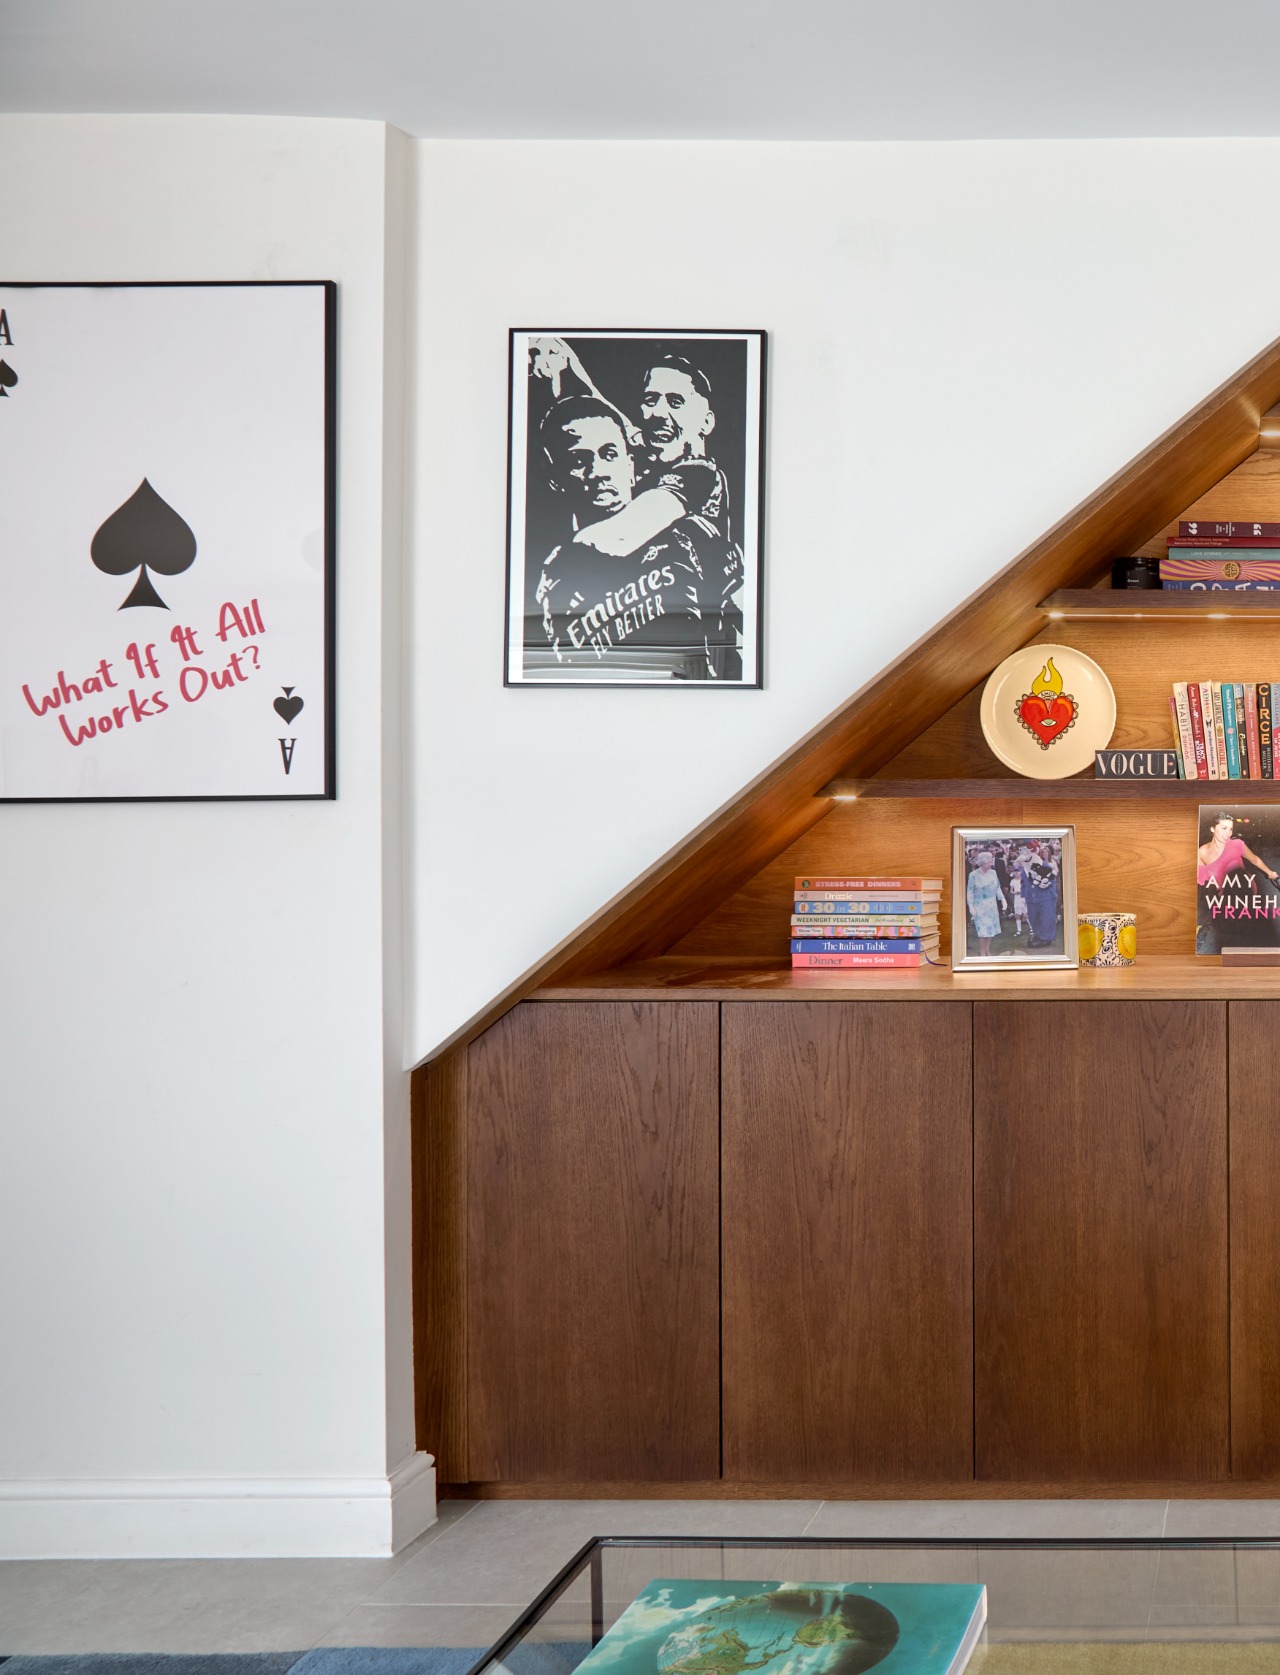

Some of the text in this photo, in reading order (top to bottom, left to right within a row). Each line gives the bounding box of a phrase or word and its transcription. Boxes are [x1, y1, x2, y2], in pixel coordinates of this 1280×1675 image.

[614, 594, 666, 641] BETTER
[22, 598, 266, 716] What If It All
[179, 645, 261, 702] Out?
[1181, 703, 1189, 732] HABIT
[1215, 703, 1223, 725] LAWRENCE
[1258, 684, 1271, 745] CIRCE
[278, 738, 297, 775] A
[1096, 752, 1176, 776] VOGUE
[1219, 738, 1227, 766] INVINCIBLE
[1205, 874, 1257, 889] AMY
[812, 902, 870, 913] 30 in 30
[825, 892, 853, 900] Drizzle
[823, 942, 888, 950] The Italian Table
[808, 955, 843, 965] Dinner
